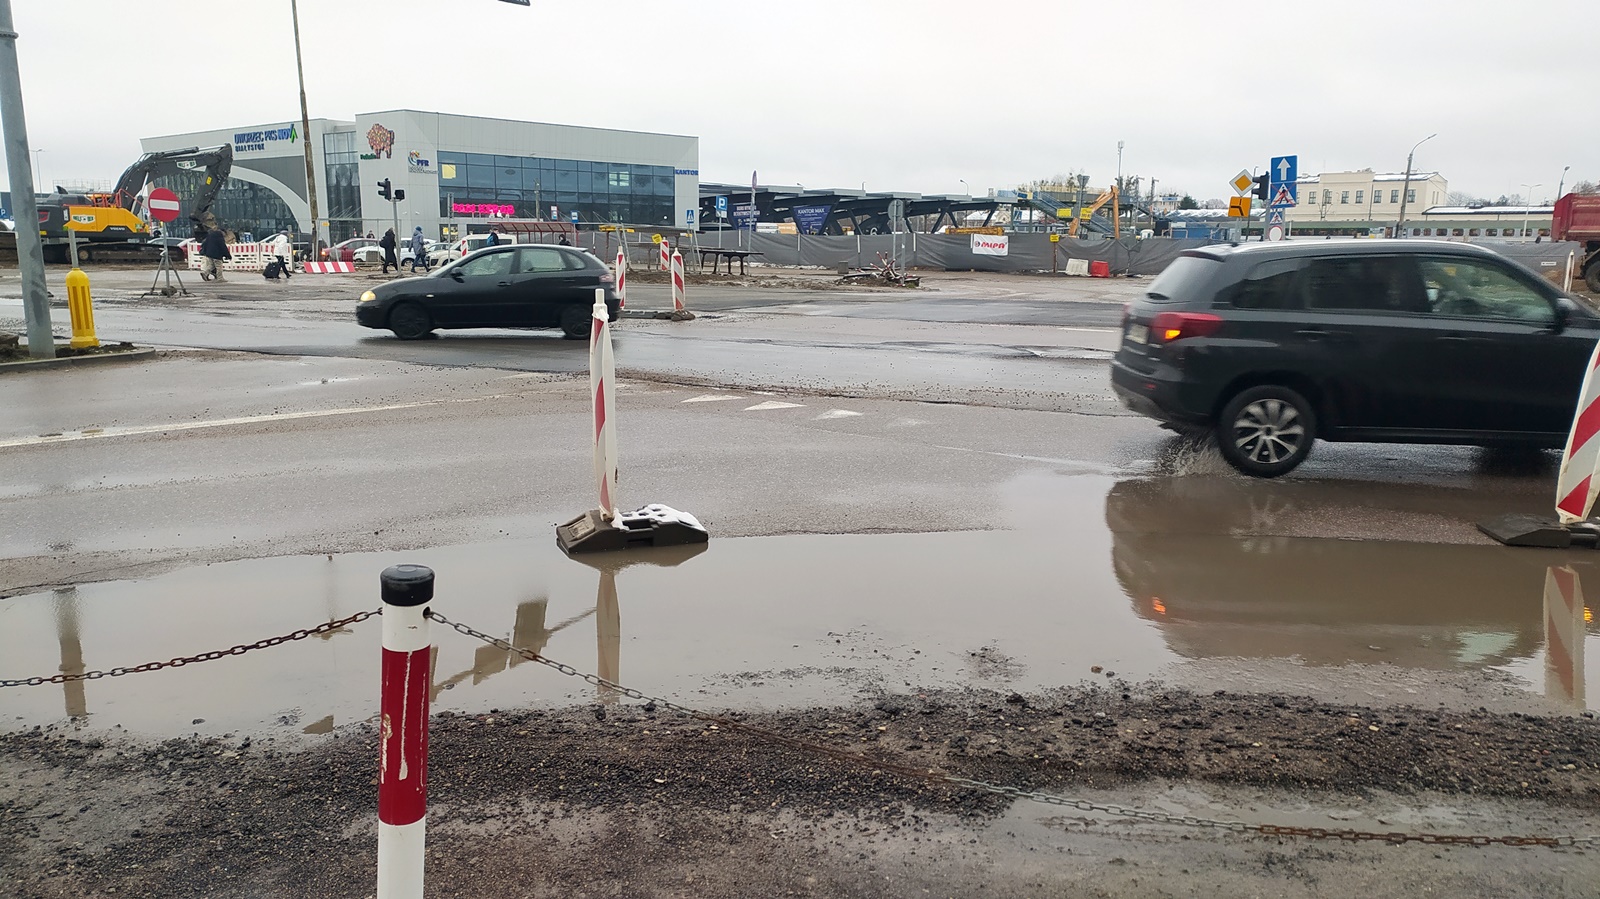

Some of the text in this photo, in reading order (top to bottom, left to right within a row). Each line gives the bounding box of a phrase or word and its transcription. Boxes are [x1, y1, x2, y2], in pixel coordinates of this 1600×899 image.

[416, 159, 430, 167] PFR
[718, 197, 726, 209] P
[981, 241, 1006, 249] MIPA
